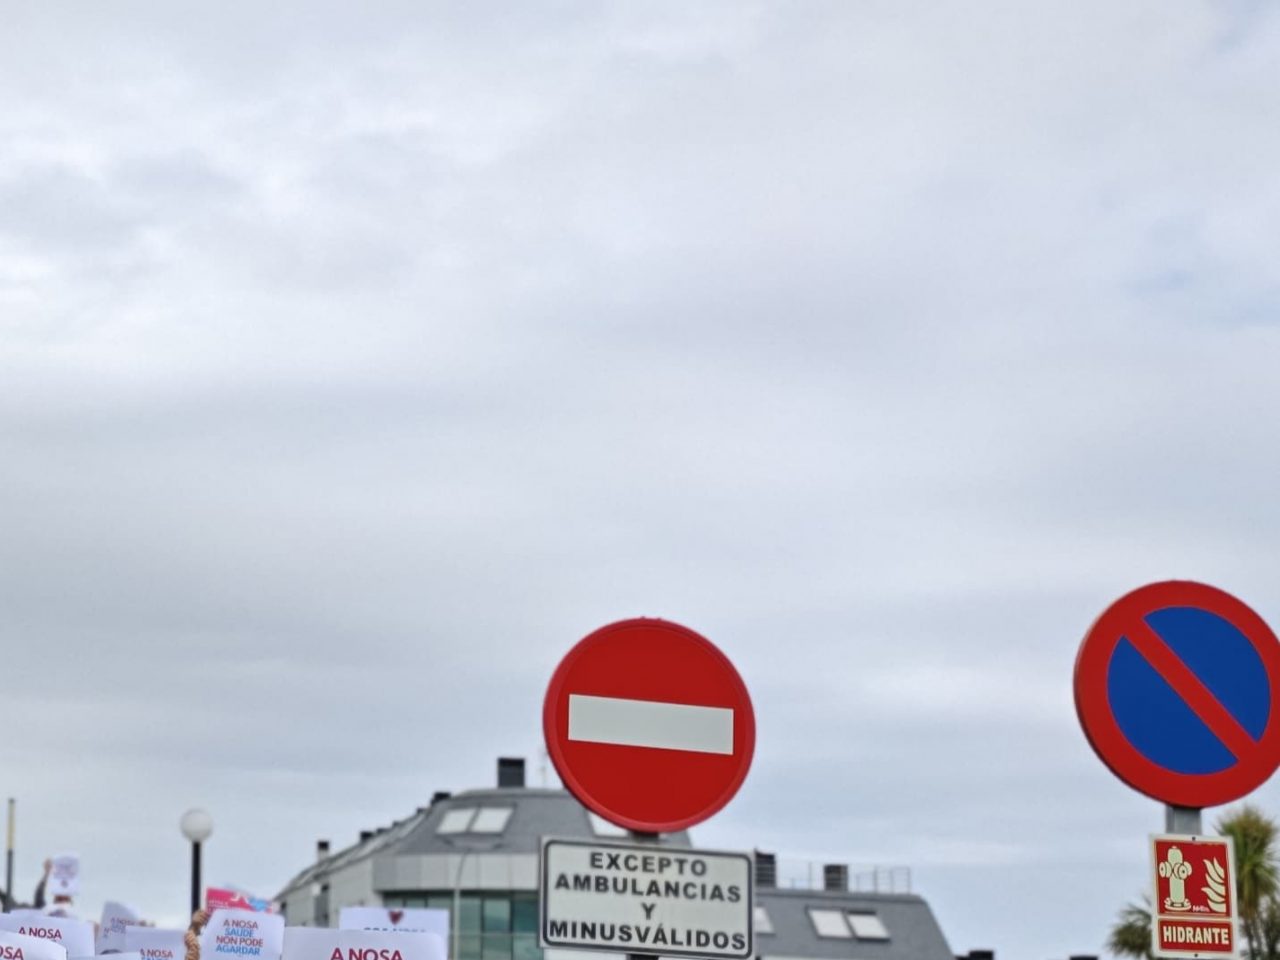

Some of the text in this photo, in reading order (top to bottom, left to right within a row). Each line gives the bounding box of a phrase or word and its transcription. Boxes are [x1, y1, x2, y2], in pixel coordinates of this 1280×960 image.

[590, 852, 707, 876] EXCEPTO
[555, 873, 741, 903] AMBULANCIAS
[642, 903, 656, 920] Y
[550, 920, 746, 950] MINUSVÁLIDOS
[1163, 926, 1229, 944] HIDRANTE
